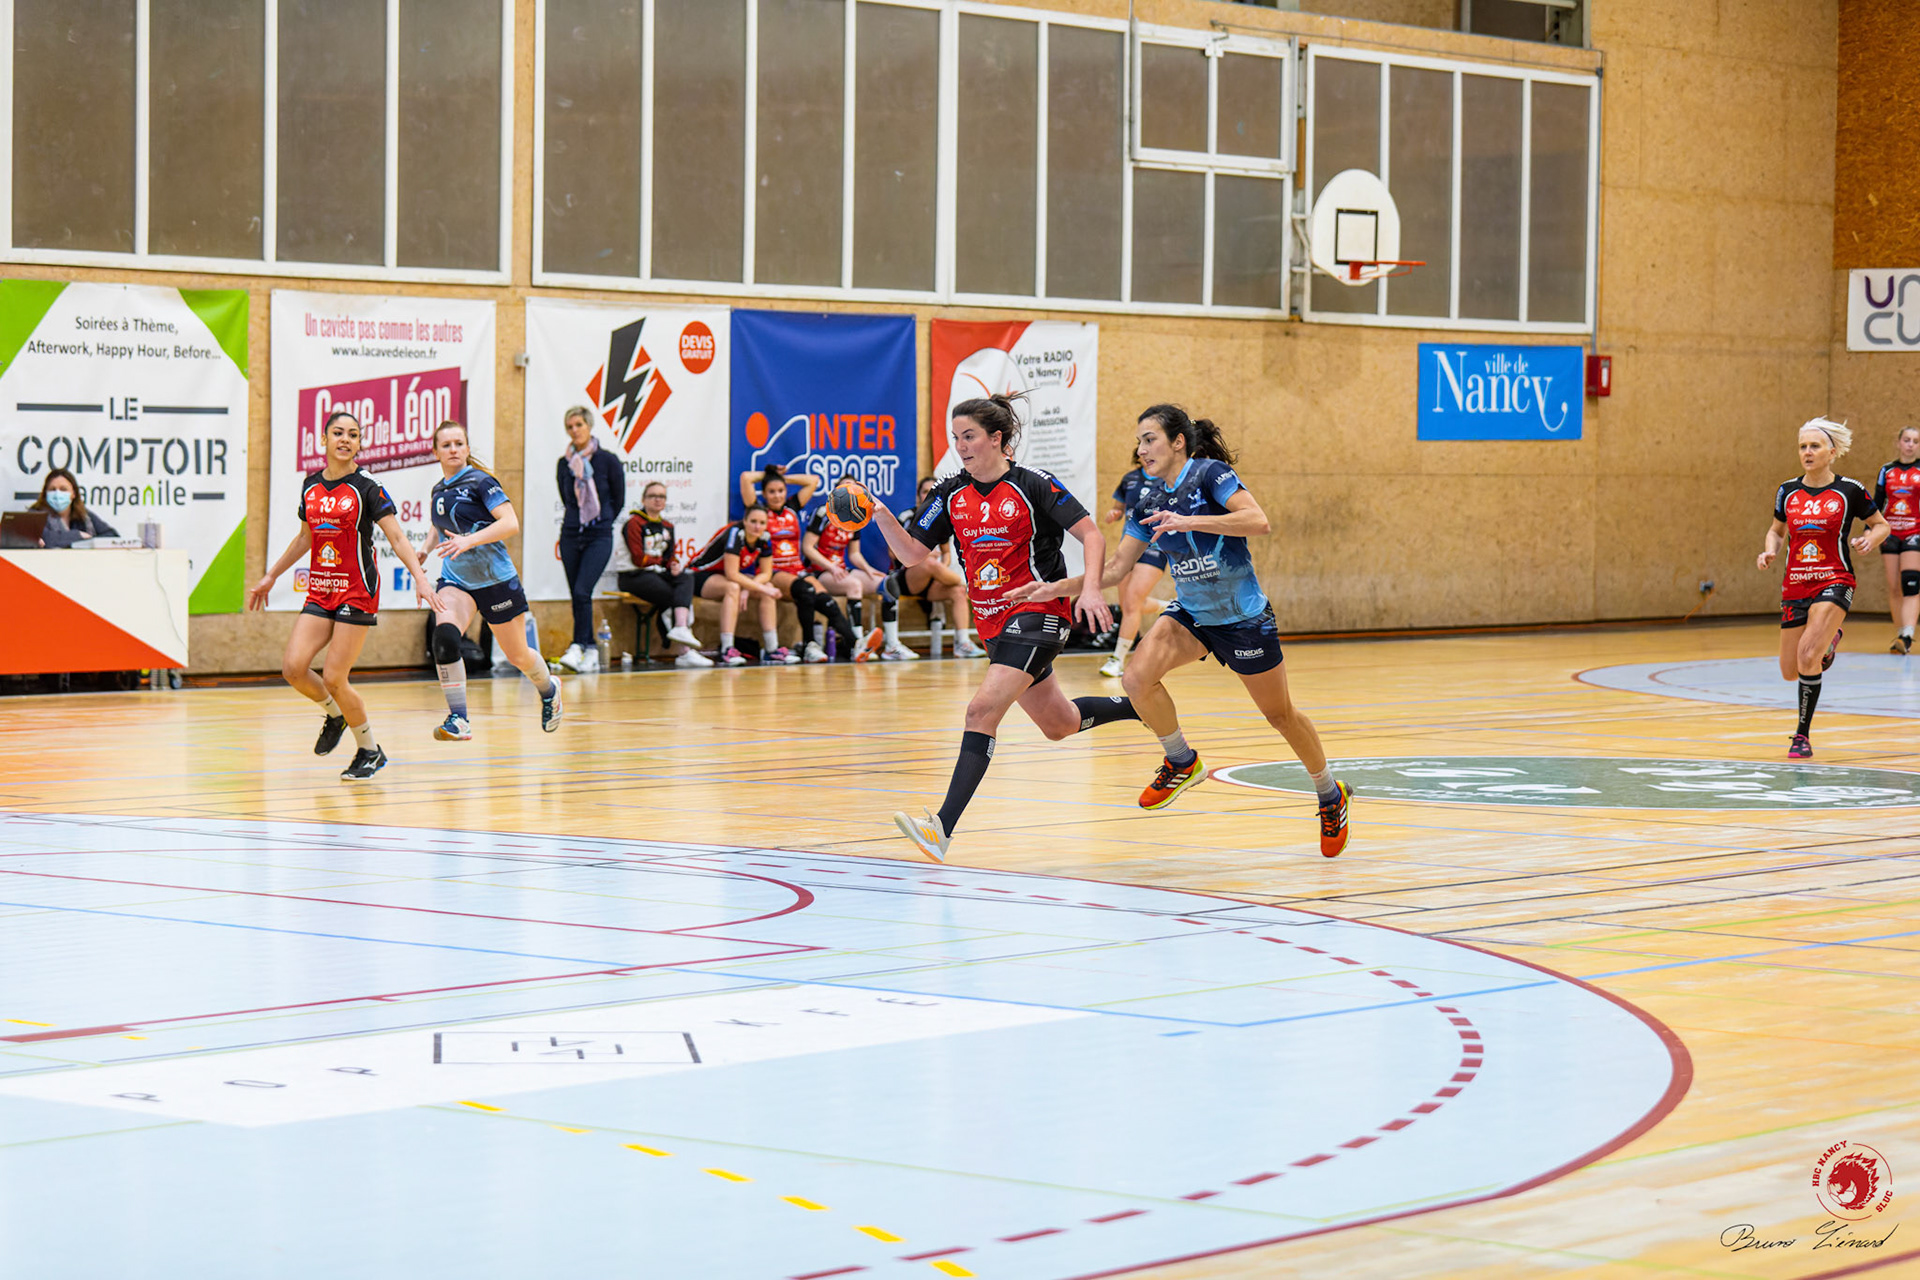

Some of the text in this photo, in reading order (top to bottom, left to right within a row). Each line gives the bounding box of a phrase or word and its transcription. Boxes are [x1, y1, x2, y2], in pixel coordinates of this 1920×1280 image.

[75, 316, 179, 335] Soirées à Thème,
[305, 312, 463, 343] Un caviste pas comme les autres
[27, 340, 93, 357] Afterwork,
[96, 343, 133, 359] Happy
[138, 344, 170, 360] Hour,
[331, 345, 437, 359] www.lacavedeleon.fr
[681, 335, 713, 349] DEVIS
[681, 349, 713, 360] GRATUIT
[1015, 350, 1073, 365] Votre RADIO
[1484, 353, 1529, 374] ville de
[1036, 367, 1062, 379] Nancy
[1432, 350, 1568, 432] Nancy
[110, 397, 138, 420] LE
[302, 426, 314, 457] la
[374, 414, 390, 446] de
[809, 413, 896, 450] INTER
[17, 435, 228, 475] COMPTOIR
[806, 454, 899, 496] SPORT
[78, 480, 187, 516] ampanile
[436, 497, 445, 515] 6
[1801, 499, 1821, 515] 26
[401, 500, 423, 522] 84
[963, 525, 1009, 537] Guy Hoquet
[1789, 570, 1836, 581] COMPTOIR
